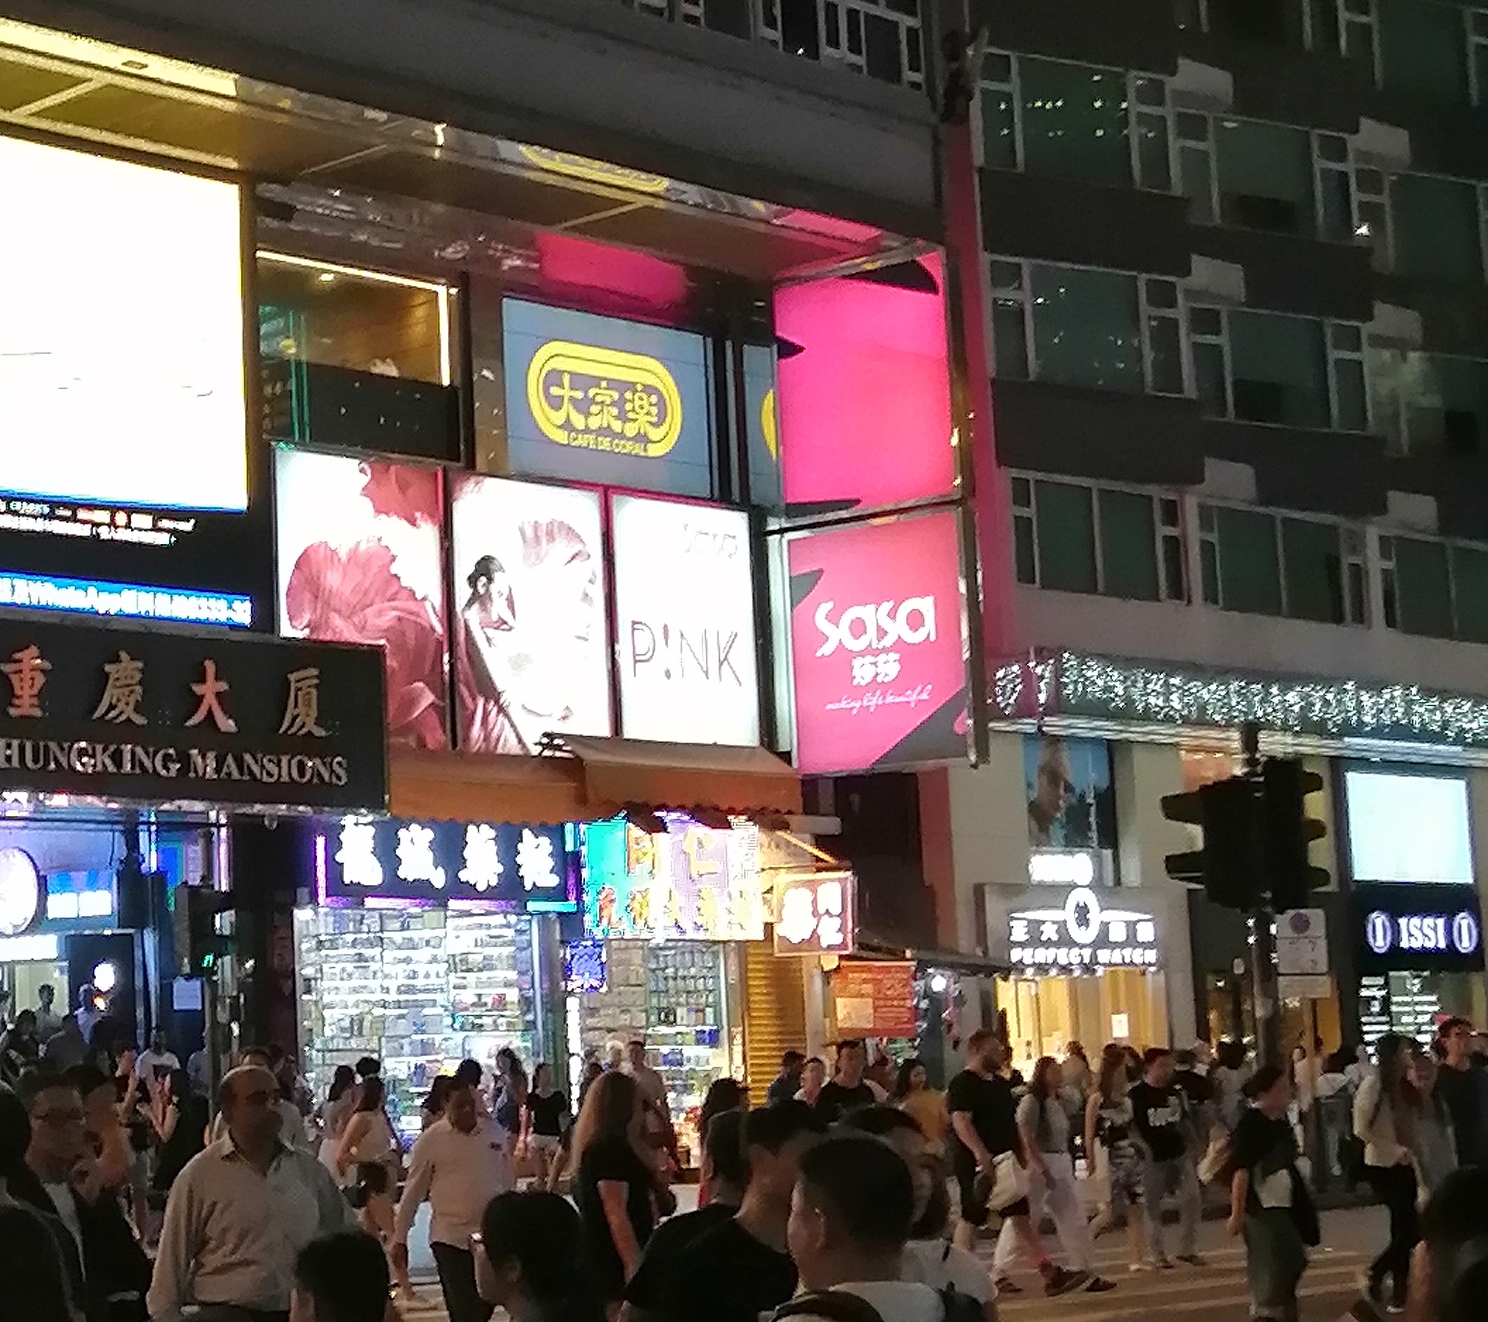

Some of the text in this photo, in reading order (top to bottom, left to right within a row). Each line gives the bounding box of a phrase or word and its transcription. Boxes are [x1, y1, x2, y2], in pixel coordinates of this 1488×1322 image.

[630, 619, 742, 687] P!NK
[188, 748, 350, 787] MANSIONS
[1398, 917, 1447, 949] ISSI
[1009, 947, 1158, 966] PERFECT WATCH
